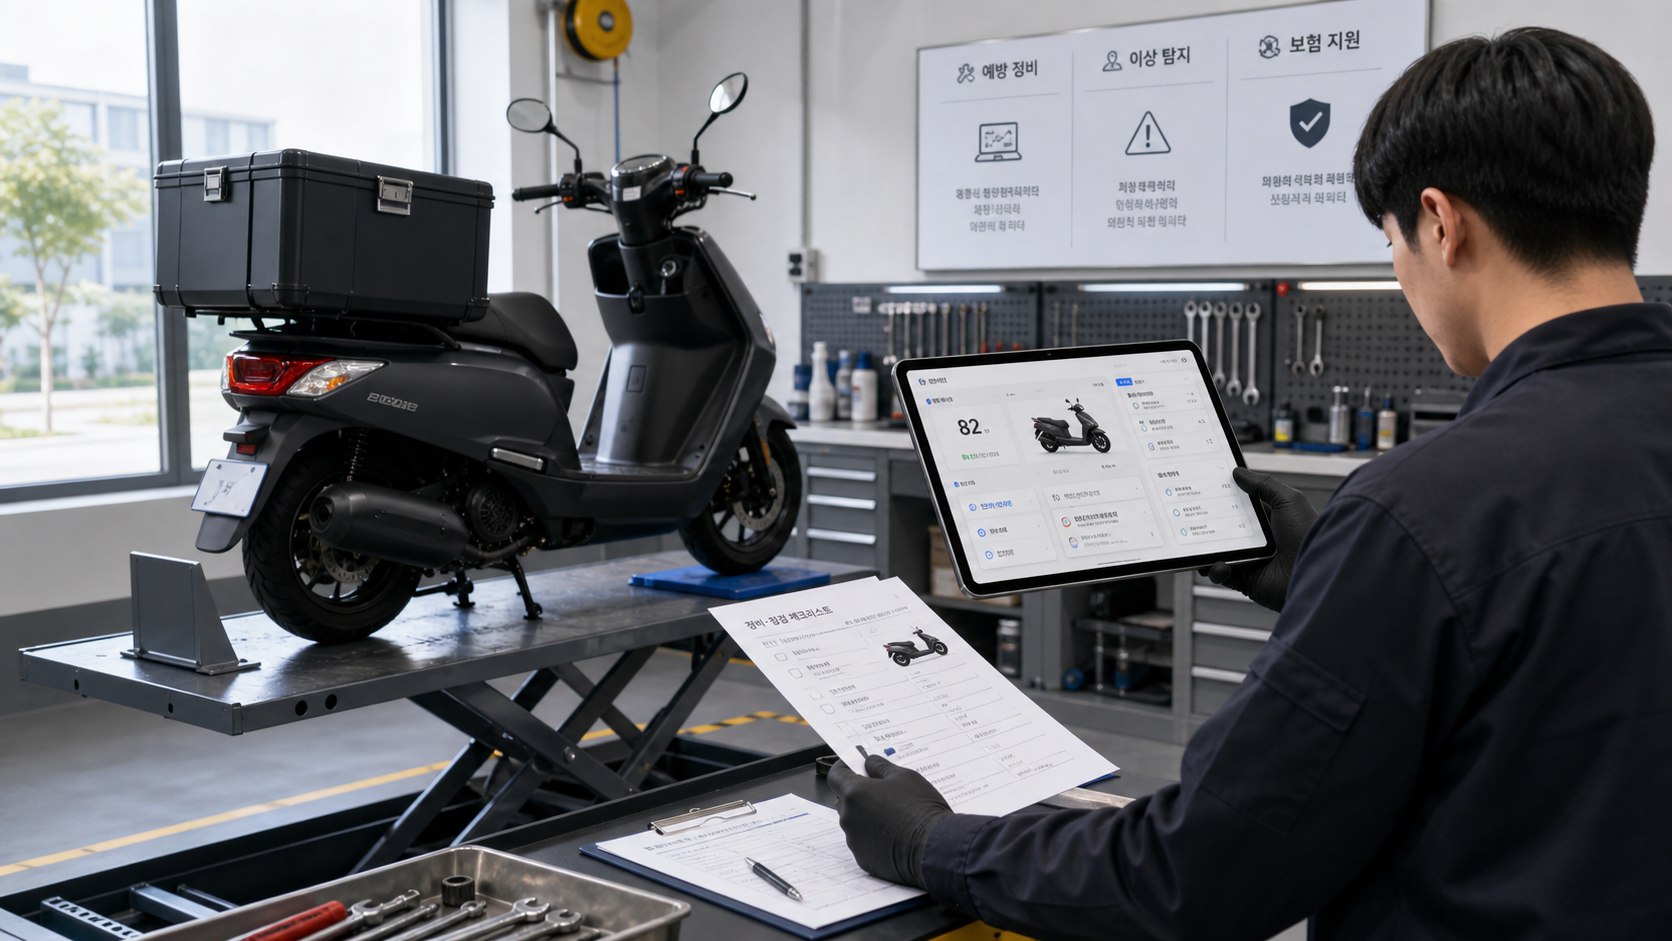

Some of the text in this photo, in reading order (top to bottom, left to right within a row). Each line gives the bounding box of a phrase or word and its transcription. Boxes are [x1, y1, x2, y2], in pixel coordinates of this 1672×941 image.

[1289, 29, 1360, 53] 보험 지원
[1129, 45, 1190, 68] 이상 탐지
[982, 59, 1038, 80] 예방 정비
[957, 418, 983, 436] 82
